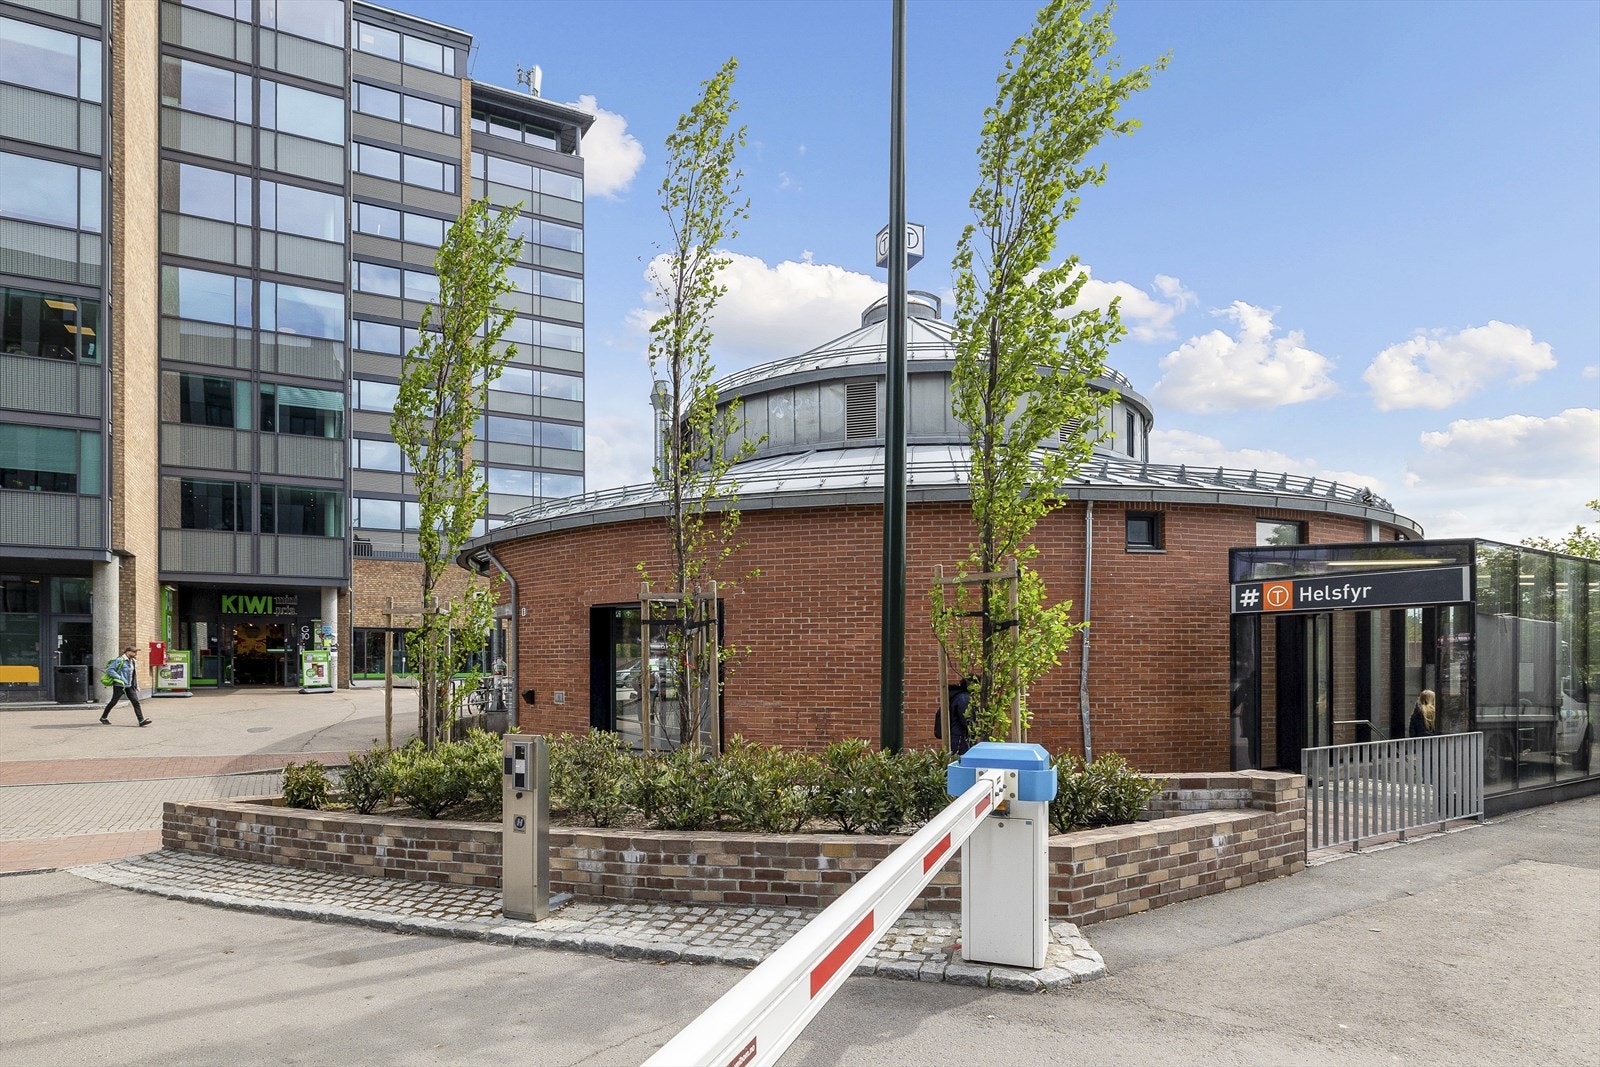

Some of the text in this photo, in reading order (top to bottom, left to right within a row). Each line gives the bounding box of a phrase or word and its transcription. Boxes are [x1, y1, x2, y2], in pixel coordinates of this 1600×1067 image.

[274, 595, 298, 605] mini
[1300, 584, 1372, 603] Helsfyr
[221, 595, 273, 614] KIWI
[301, 625, 310, 633] G
